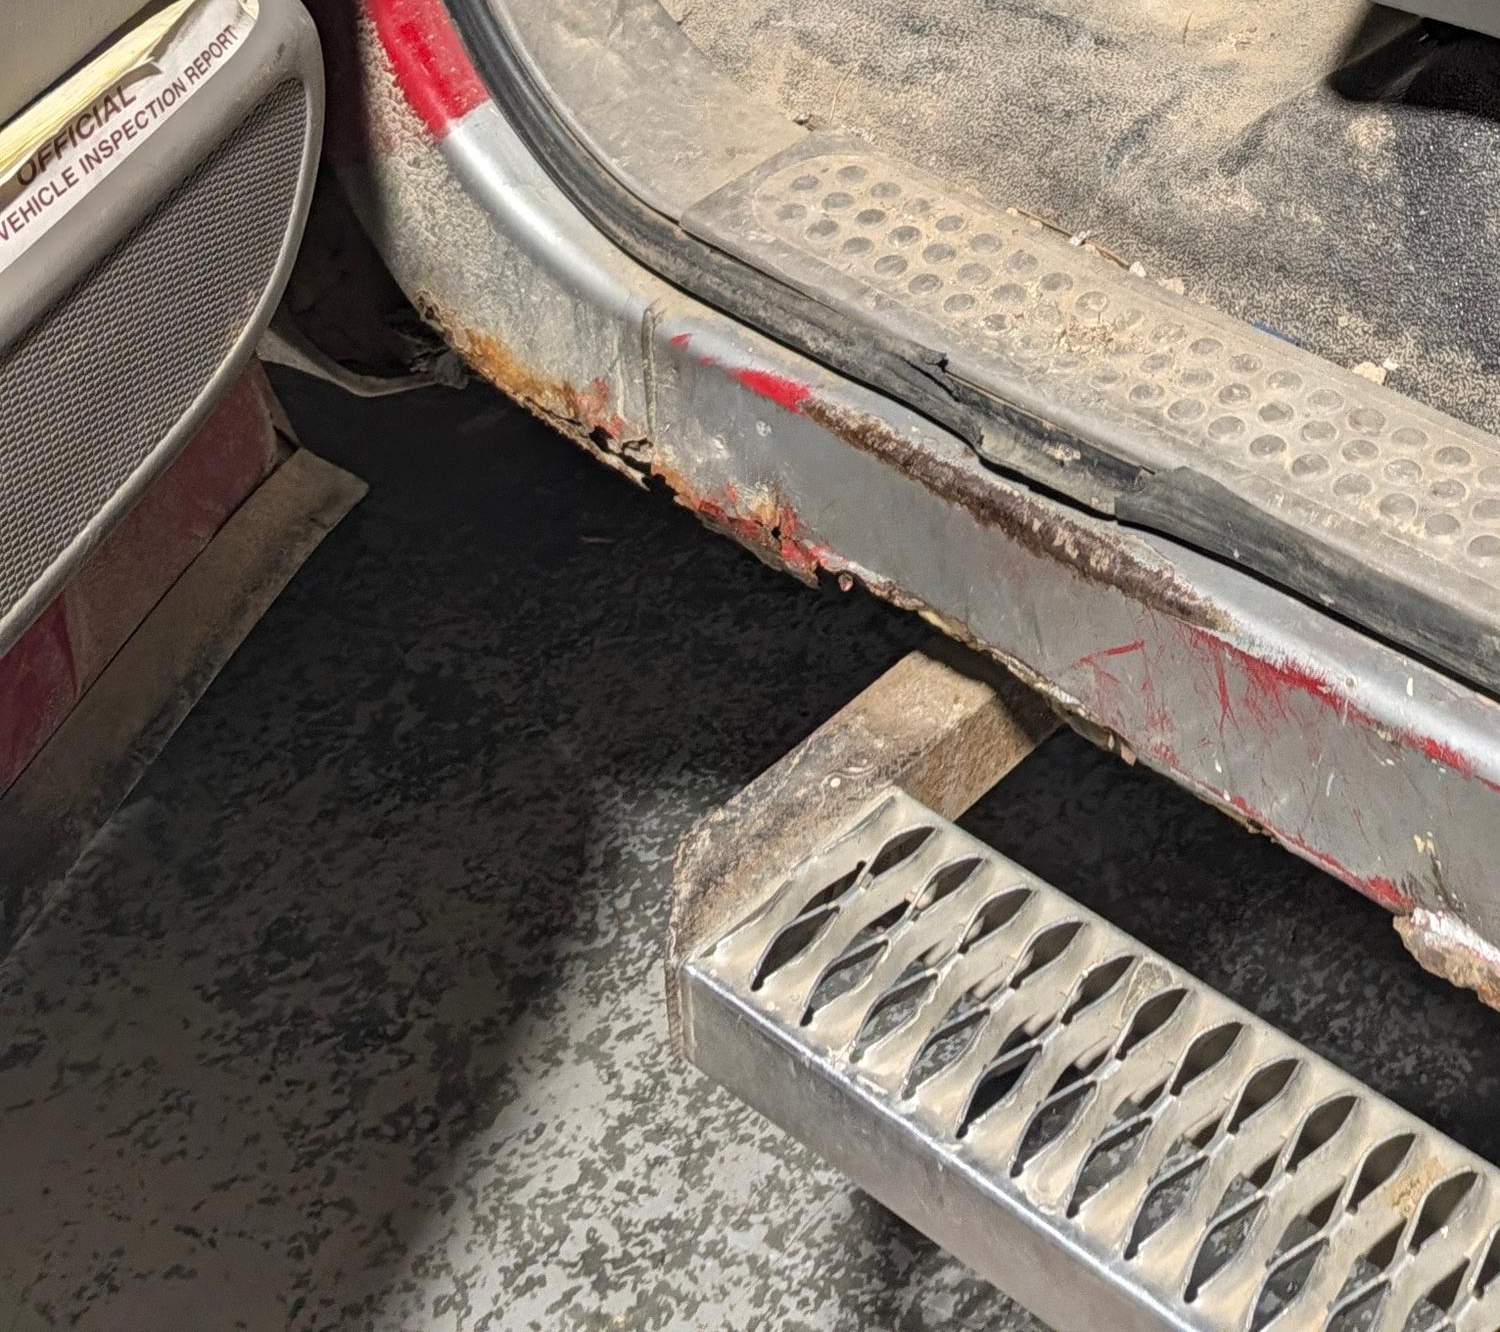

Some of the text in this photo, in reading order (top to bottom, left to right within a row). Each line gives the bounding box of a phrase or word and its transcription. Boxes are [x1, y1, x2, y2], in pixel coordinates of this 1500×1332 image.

[0, 24, 239, 241] VEHICLE INSPECTION REPORT
[17, 85, 137, 186] OFFICIAL
